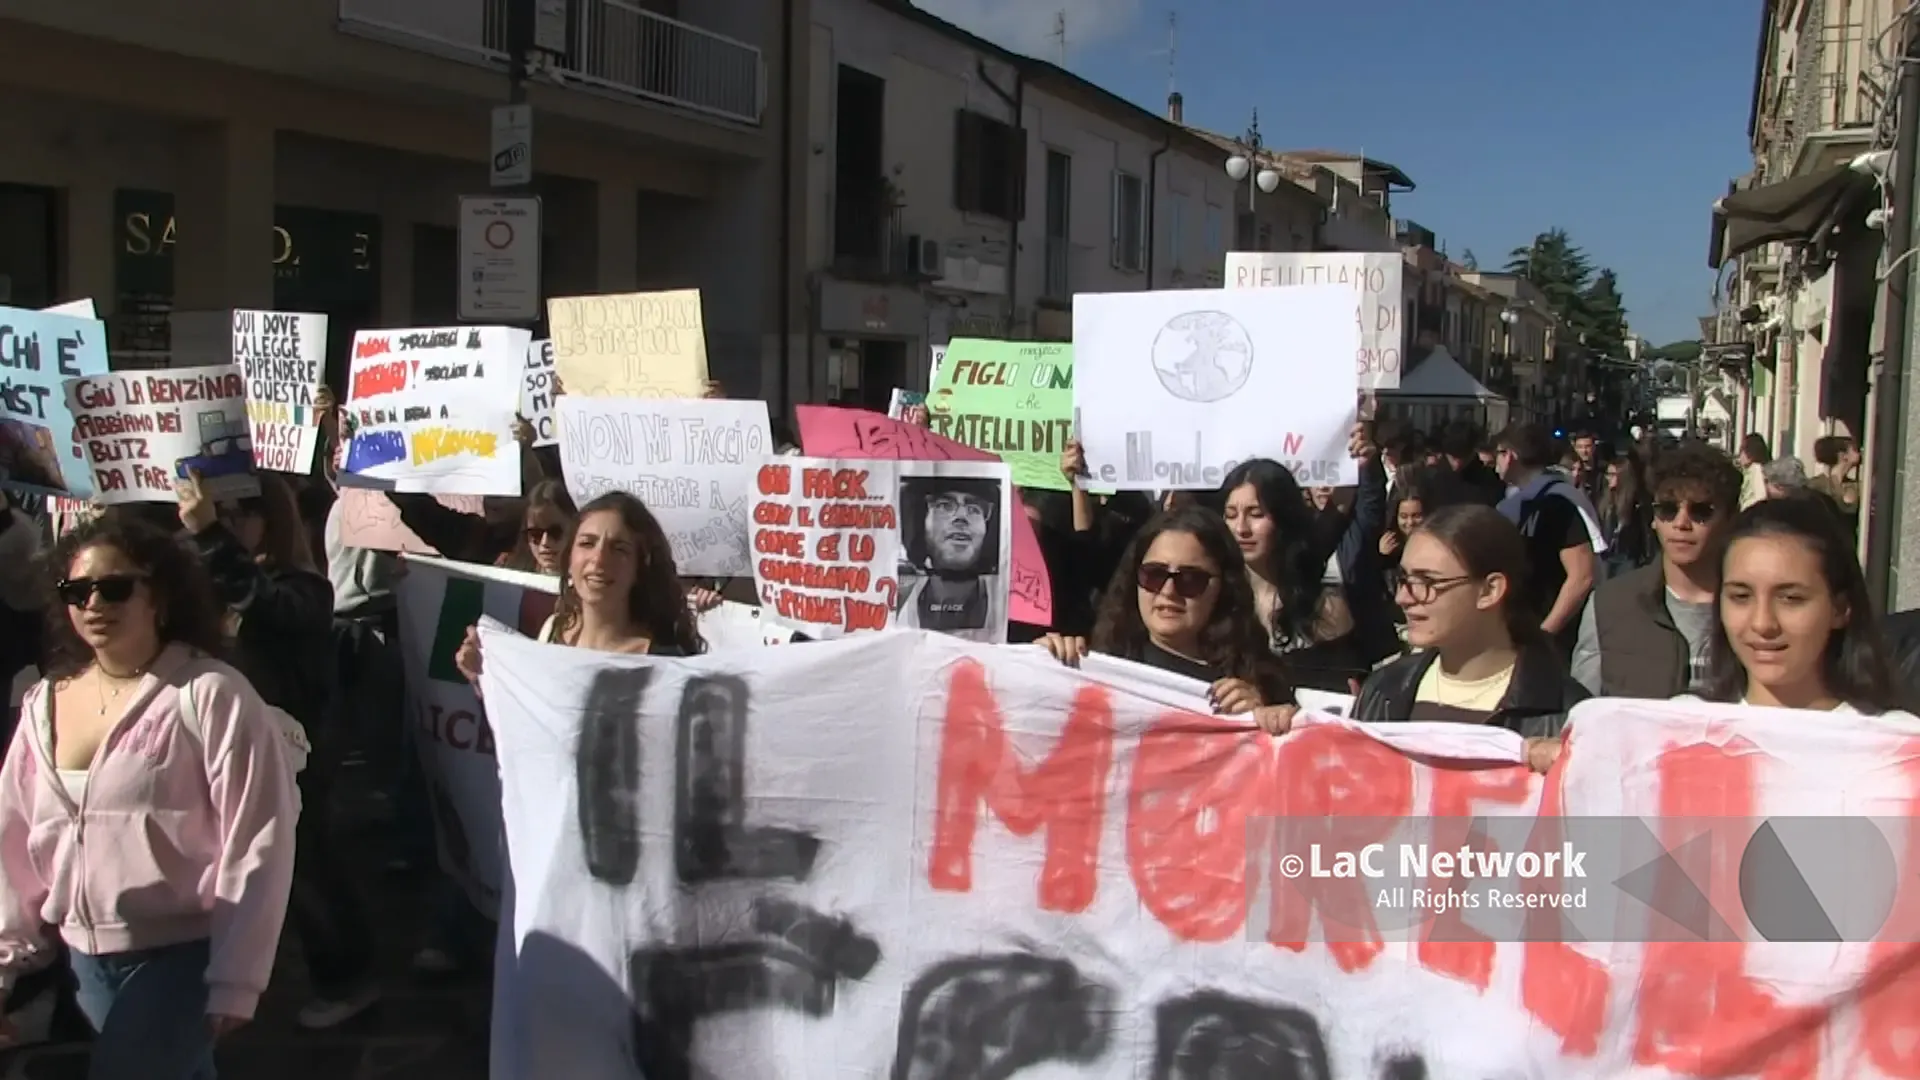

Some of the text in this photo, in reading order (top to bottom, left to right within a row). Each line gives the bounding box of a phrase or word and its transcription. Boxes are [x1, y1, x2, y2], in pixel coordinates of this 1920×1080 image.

[233, 310, 299, 336] QUI DOVE
[234, 337, 301, 359] LA LEGGE
[244, 359, 317, 383] DIPENDERE
[952, 361, 1020, 387] FIGLI
[1030, 362, 1074, 389] UN
[122, 378, 142, 405] LA
[252, 381, 312, 405] QUESTA
[1016, 392, 1042, 410] che
[256, 424, 301, 448] NASCI
[562, 410, 633, 466] NON
[1283, 432, 1304, 456] N
[1126, 431, 1219, 484] Monde
[95, 464, 173, 493] DA FARE
[709, 480, 727, 511] A
[753, 501, 793, 526] CON
[799, 506, 814, 527] IL
[755, 529, 805, 559] COME
[575, 663, 825, 888] IL
